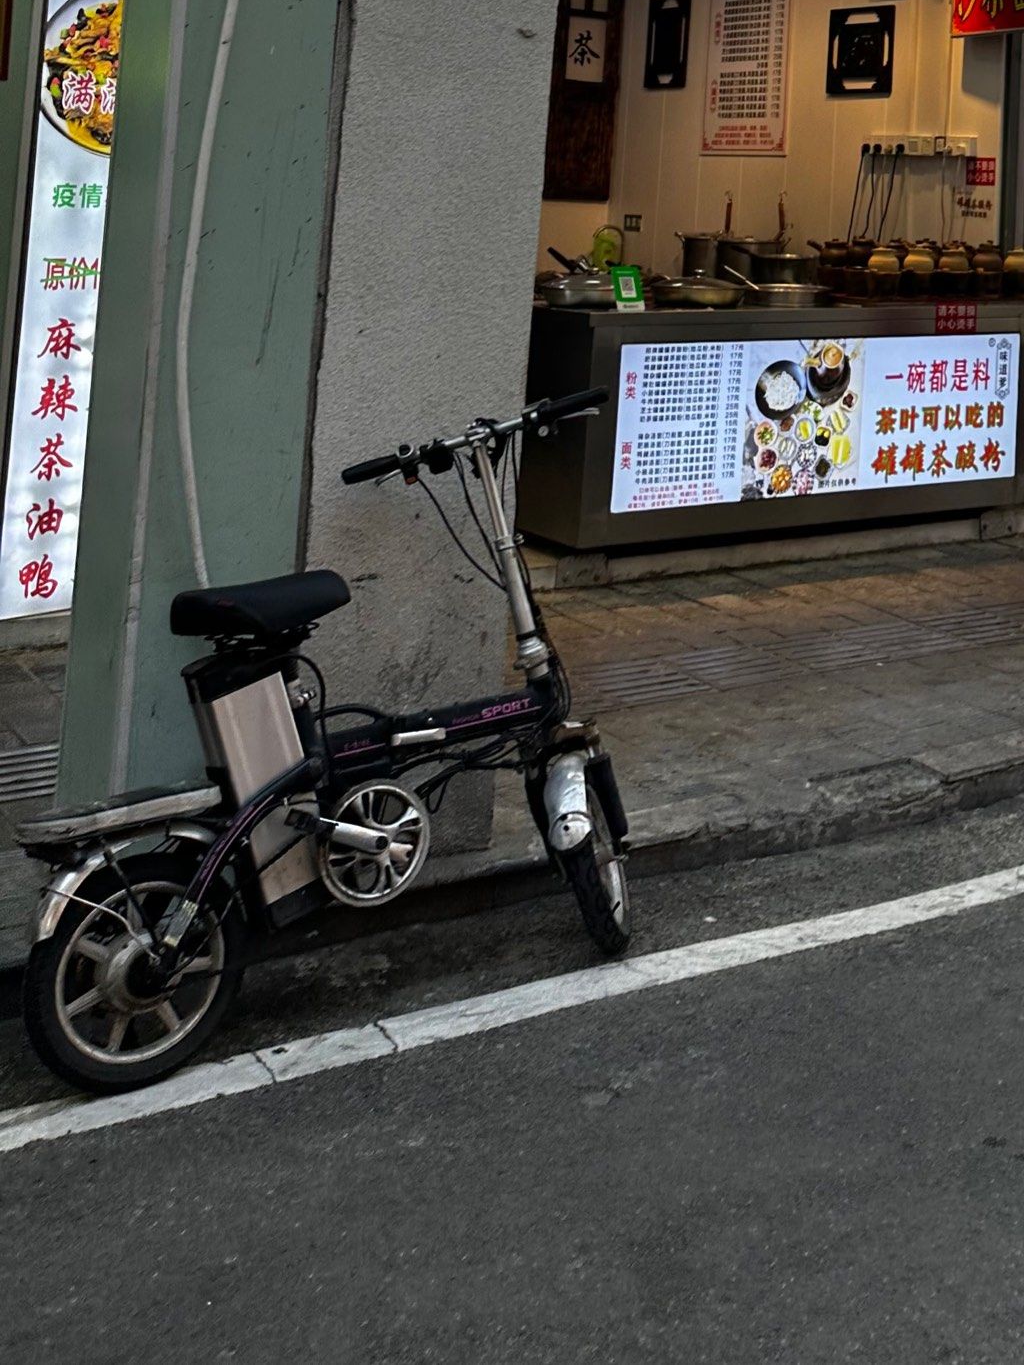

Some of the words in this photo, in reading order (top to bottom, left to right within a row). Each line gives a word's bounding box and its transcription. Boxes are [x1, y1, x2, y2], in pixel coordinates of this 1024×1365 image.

[568, 30, 601, 67] 茶
[885, 357, 992, 394] 一碗都是料
[875, 401, 1005, 435] 茶叶可以吃的
[18, 318, 82, 599] 麻辣茶油鸭
[871, 437, 1006, 483] 罐罐茶酸粉
[481, 697, 532, 719] SPORT
